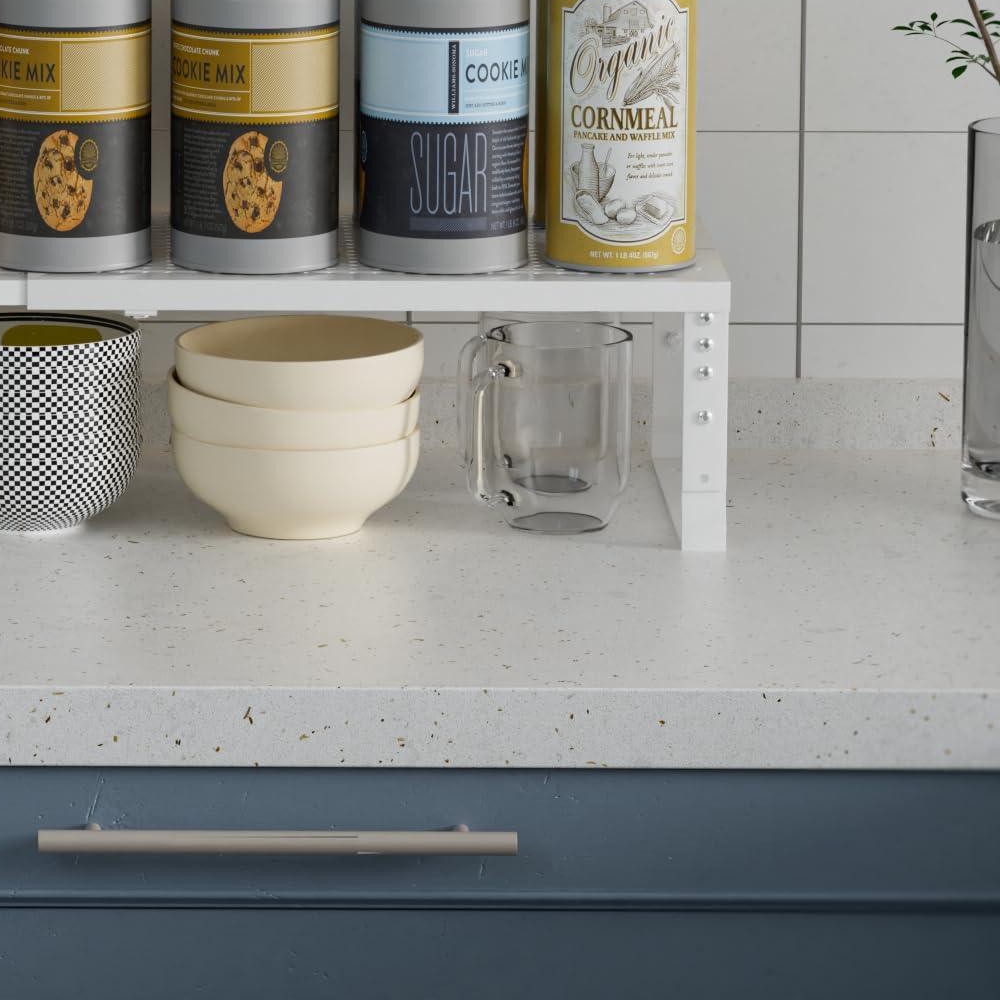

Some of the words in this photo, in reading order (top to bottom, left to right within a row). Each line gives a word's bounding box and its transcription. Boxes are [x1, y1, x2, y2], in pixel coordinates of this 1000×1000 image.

[465, 58, 519, 84] COOKIE
[570, 14, 675, 102] Organic
[26, 63, 56, 83] MIX
[216, 63, 246, 84] MIX
[571, 104, 679, 131] CORNMEAL
[573, 130, 608, 141] PANCAKE
[609, 132, 628, 141] AND
[629, 131, 660, 141] WAFFLE
[661, 130, 676, 139] MIX
[410, 131, 488, 216] SUGAR
